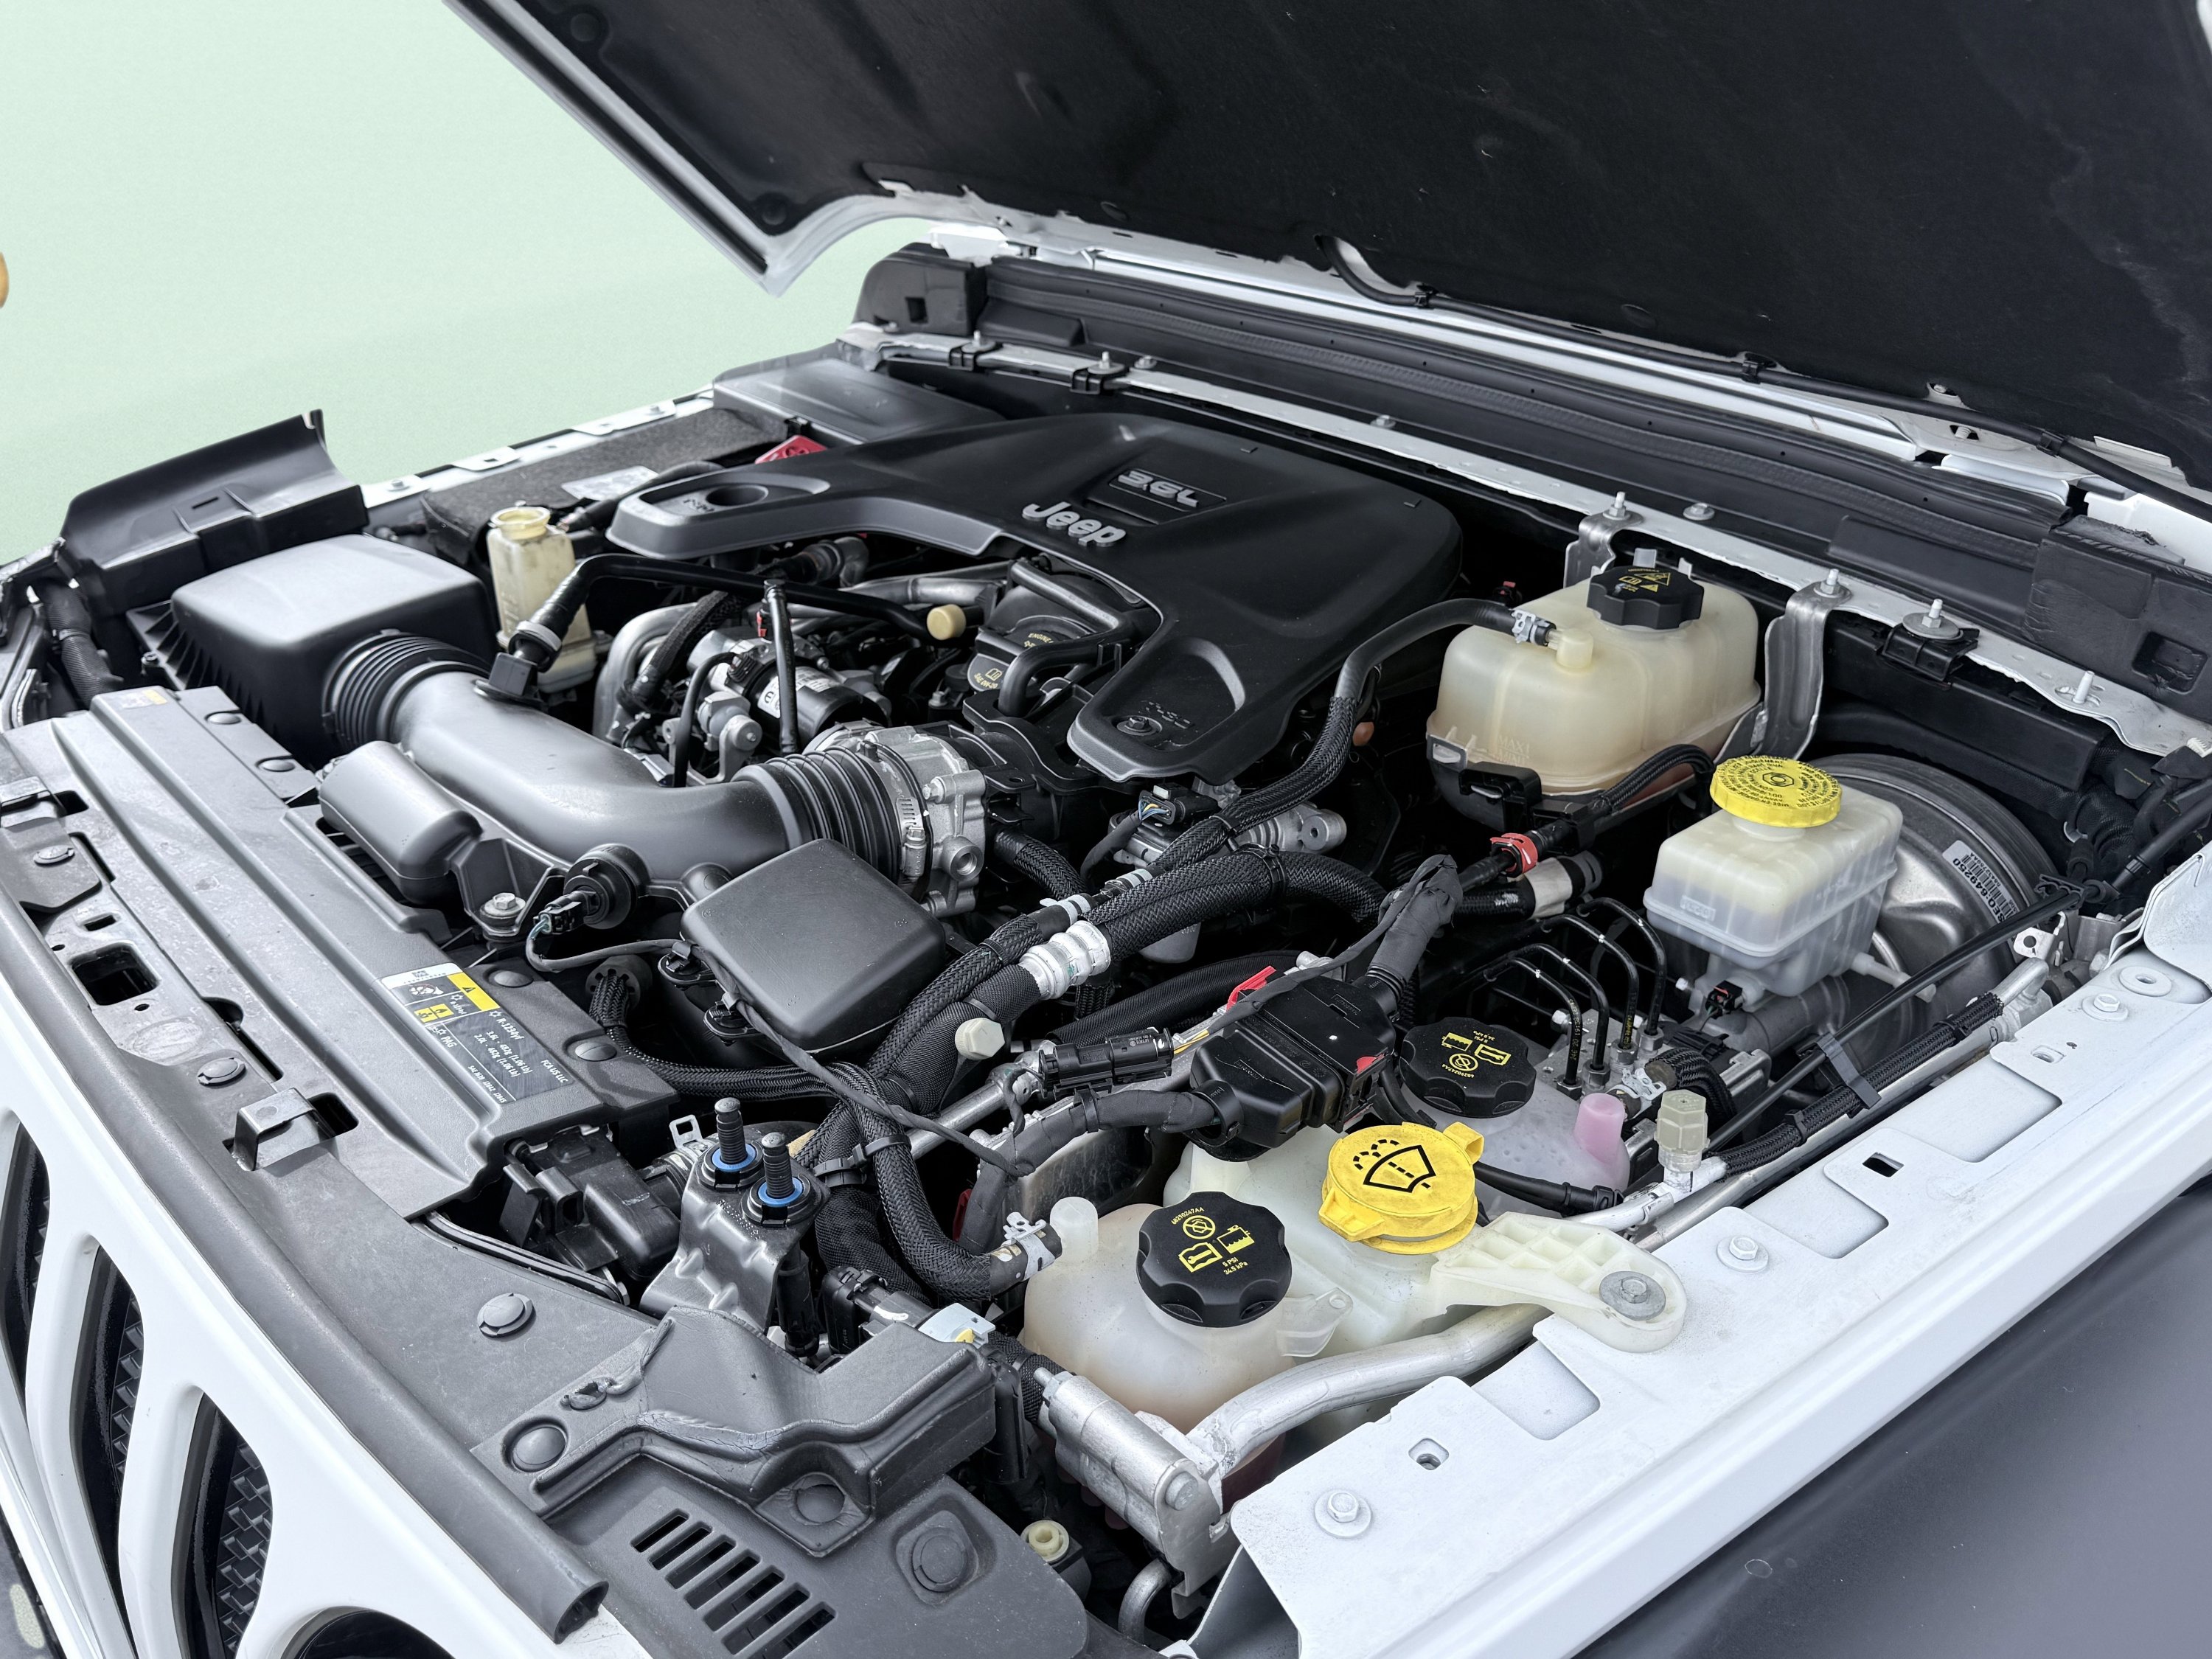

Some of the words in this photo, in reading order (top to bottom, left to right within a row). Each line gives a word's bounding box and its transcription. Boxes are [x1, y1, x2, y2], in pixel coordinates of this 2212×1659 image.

[1118, 470, 1198, 507] 3.6L
[1022, 501, 1126, 547] Jeep
[496, 1018, 525, 1040] R-1234yf
[440, 1036, 457, 1048] PAG
[540, 1060, 554, 1069] FCA
[555, 1074, 568, 1083] LLC
